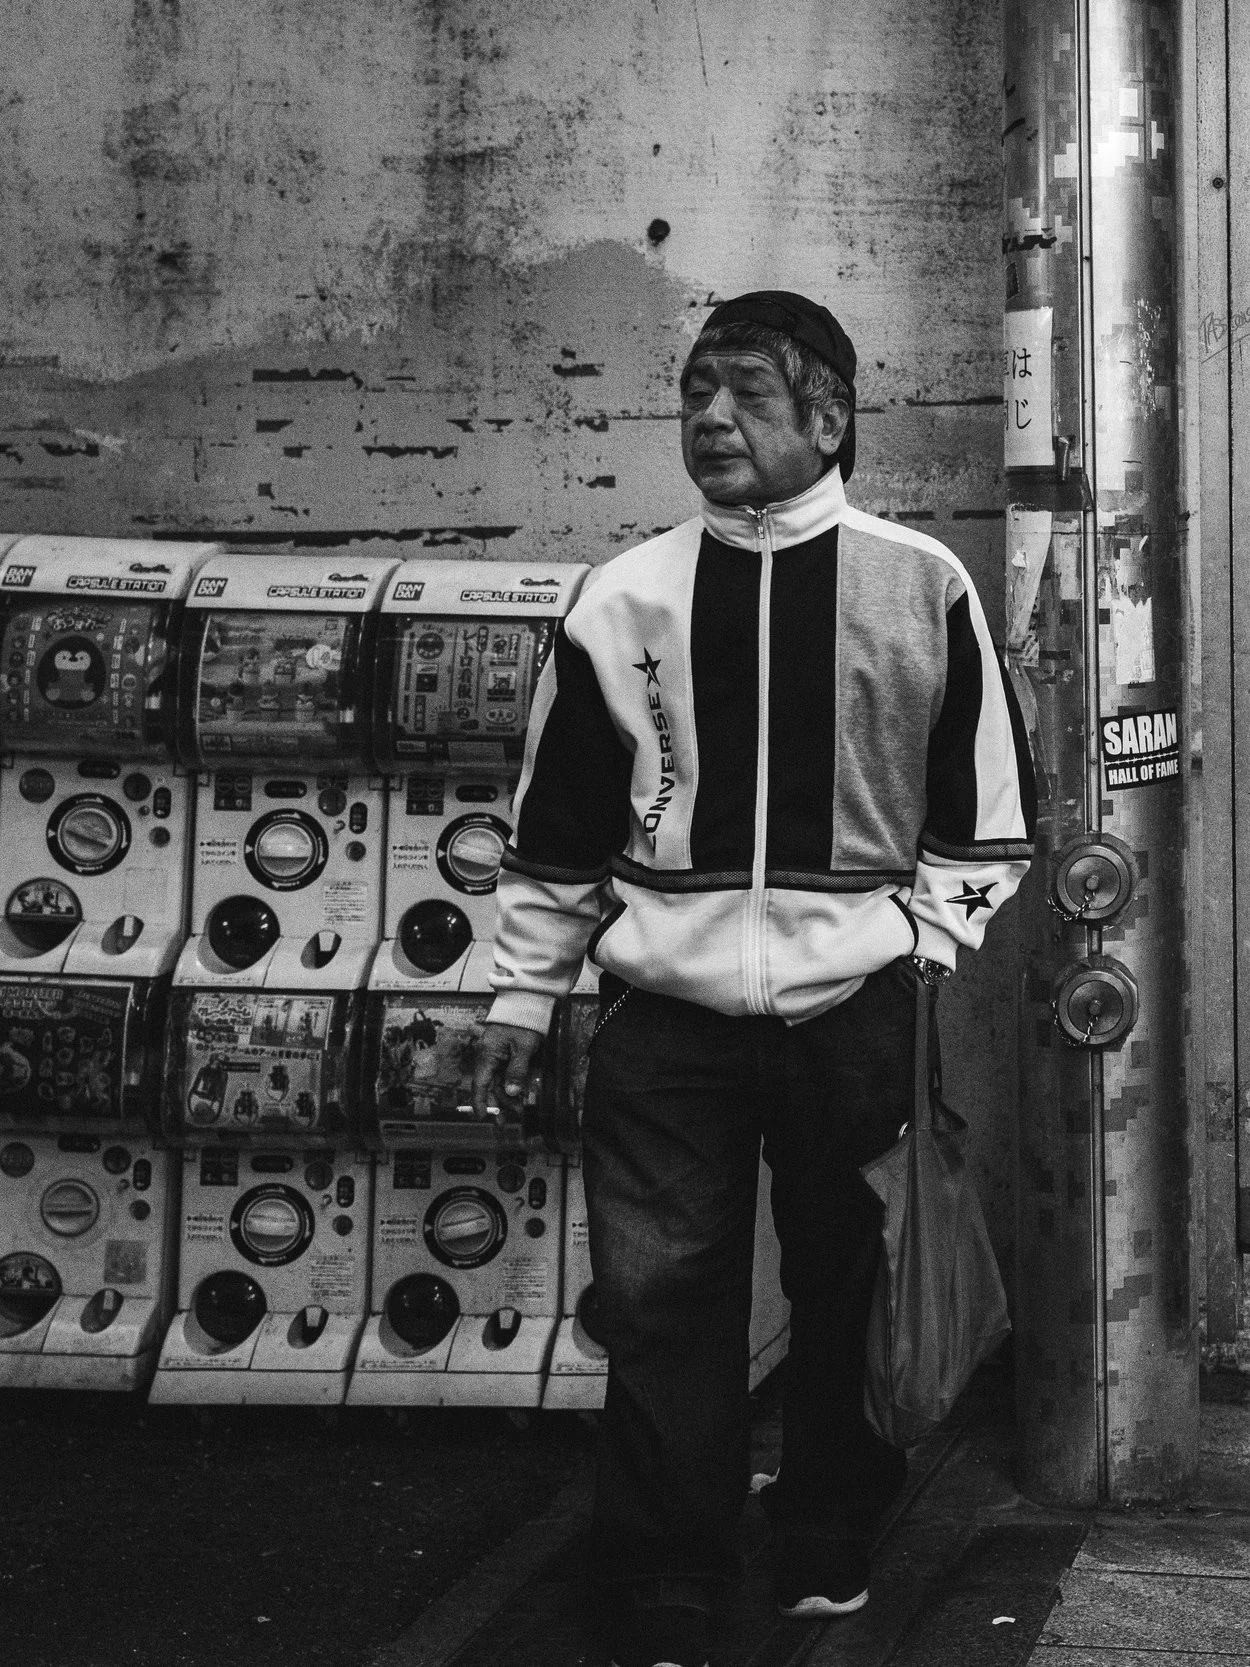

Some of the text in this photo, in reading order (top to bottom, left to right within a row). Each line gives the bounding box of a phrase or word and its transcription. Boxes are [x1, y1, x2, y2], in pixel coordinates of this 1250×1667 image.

[67, 575, 118, 590] CAPSULE
[268, 586, 319, 598] CAPSULE
[461, 591, 511, 602] CAPSULE
[1104, 713, 1177, 755] SARAN
[1108, 759, 1179, 785] HALL OF FAME
